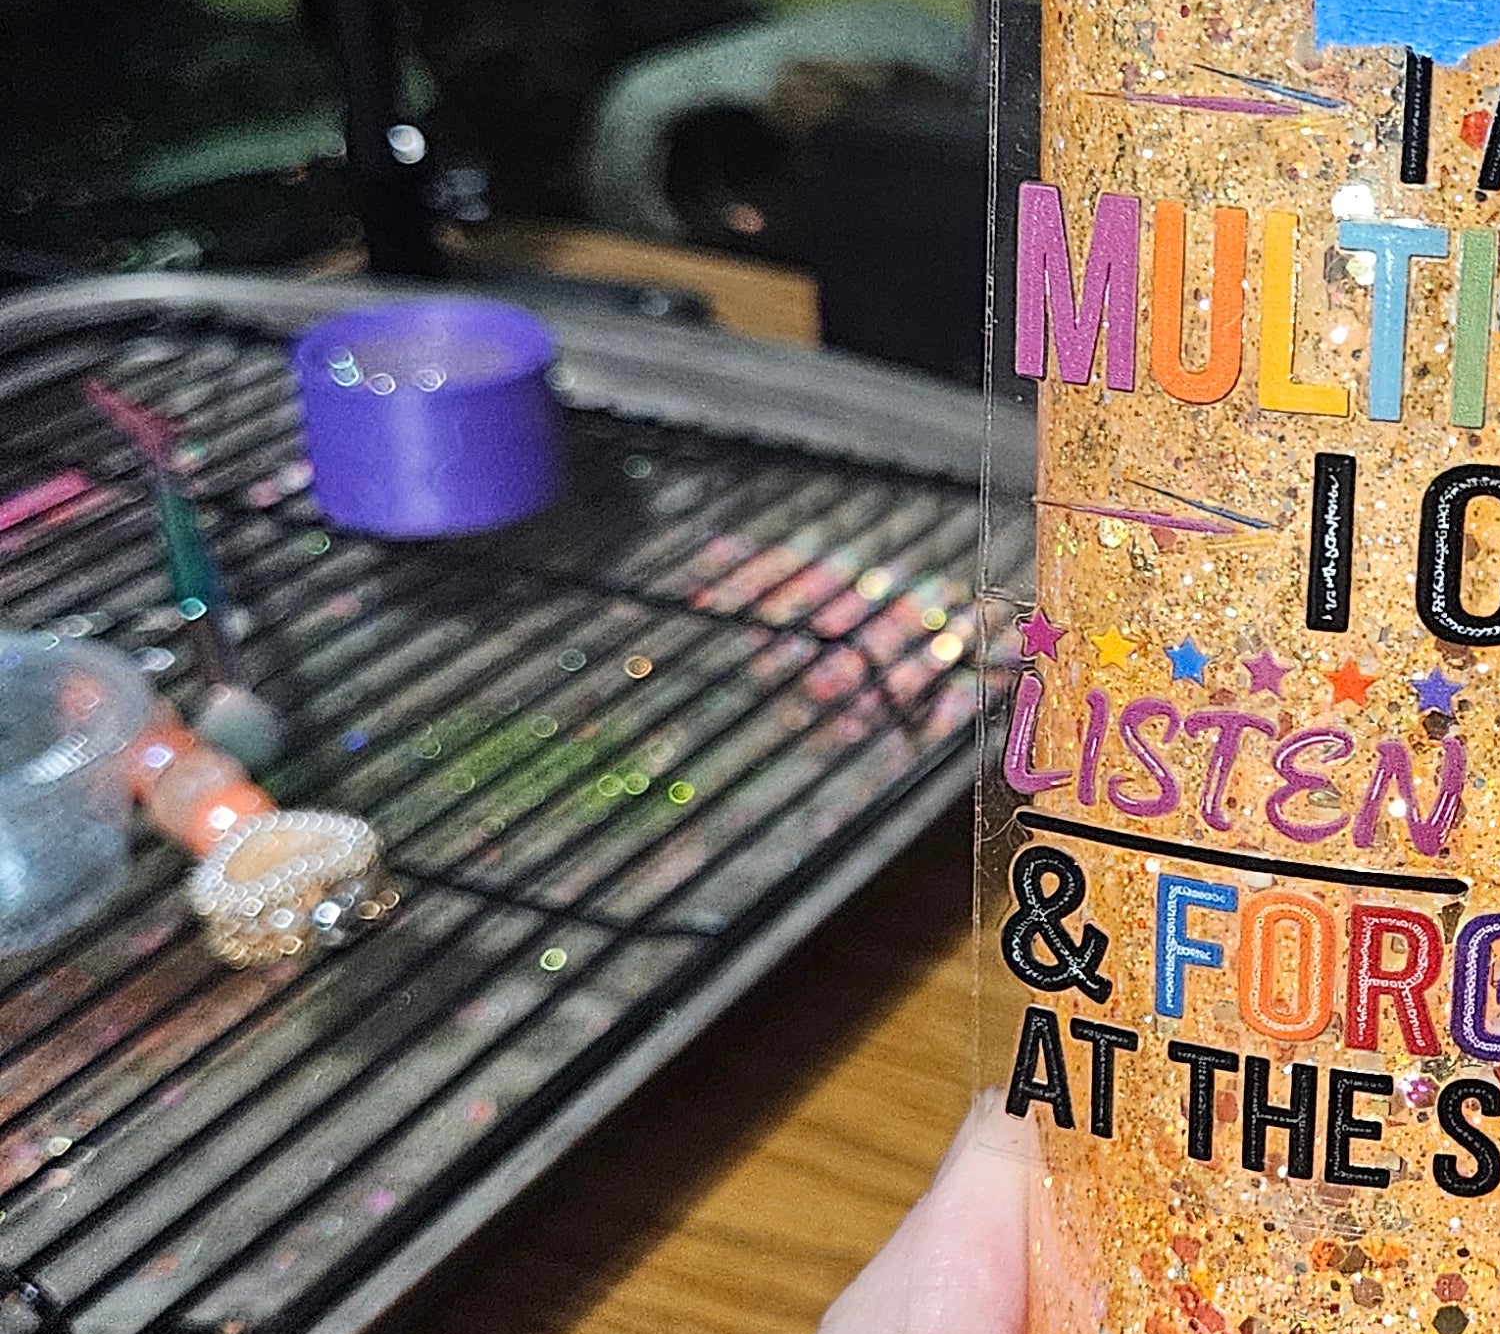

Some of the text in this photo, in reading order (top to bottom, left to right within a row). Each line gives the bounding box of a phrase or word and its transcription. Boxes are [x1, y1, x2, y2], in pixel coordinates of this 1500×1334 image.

[1400, 45, 1434, 186] I
[1305, 452, 1357, 633] I
[1003, 671, 1467, 857] LISTEN
[1001, 844, 1114, 1004] &
[1004, 1006, 1139, 1141] AT
[1168, 1040, 1395, 1189] THE
